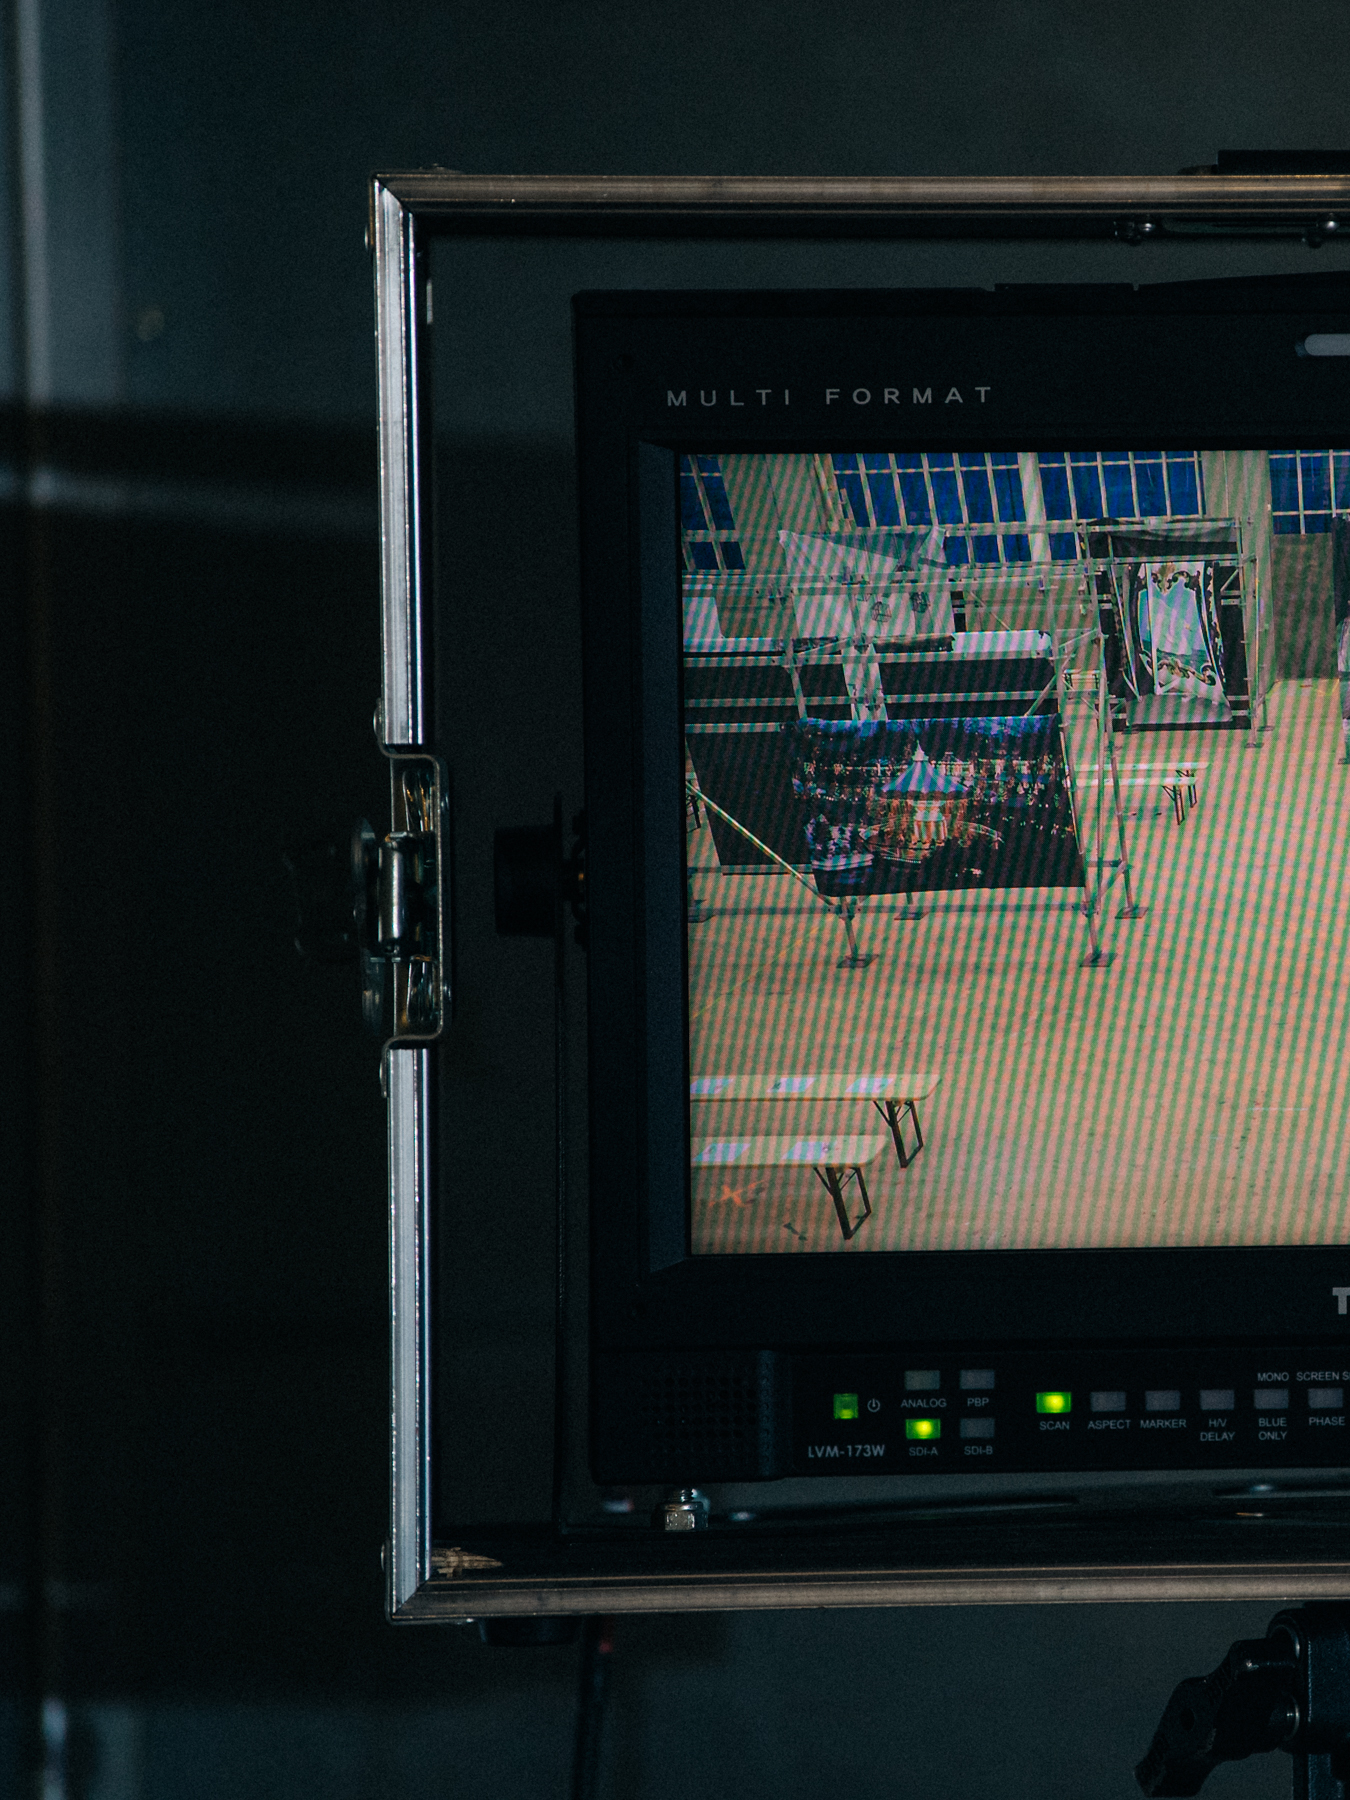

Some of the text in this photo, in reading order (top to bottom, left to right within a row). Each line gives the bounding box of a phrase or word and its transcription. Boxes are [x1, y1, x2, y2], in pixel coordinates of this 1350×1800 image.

[667, 386, 991, 406] MULTI FORMAT
[1257, 1371, 1289, 1382] MONO
[1297, 1371, 1340, 1381] SCREEN
[900, 1398, 947, 1409] ANALOG
[967, 1397, 989, 1408] PBP
[1039, 1420, 1070, 1431] SCAN
[1088, 1419, 1131, 1430] ASPECT
[1140, 1419, 1187, 1429] MARKER
[1208, 1417, 1227, 1429] H/V
[1258, 1417, 1287, 1428] BLUE
[1308, 1416, 1346, 1427] PHASE
[1200, 1431, 1236, 1442] DELAY
[1258, 1431, 1288, 1441] ONLY
[808, 1444, 886, 1458] LVM-173W
[908, 1446, 939, 1457] SDI-A
[963, 1445, 994, 1456] SDI-B
